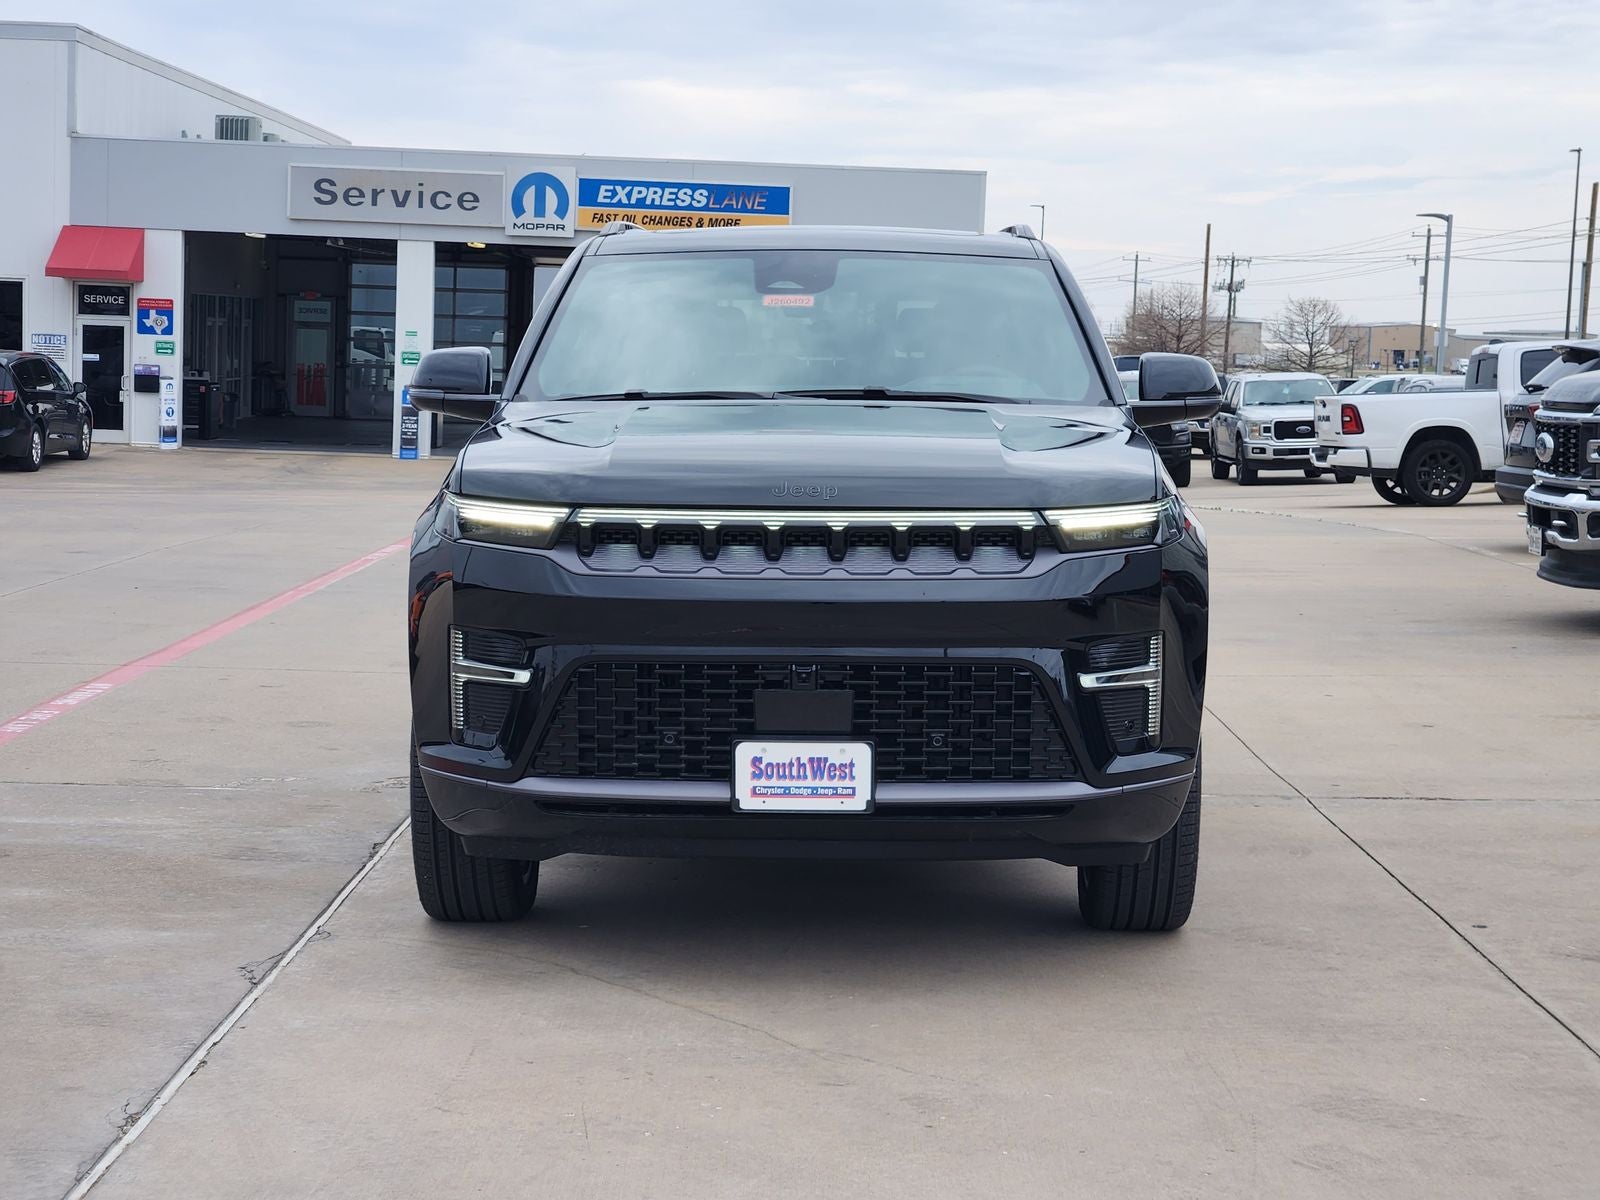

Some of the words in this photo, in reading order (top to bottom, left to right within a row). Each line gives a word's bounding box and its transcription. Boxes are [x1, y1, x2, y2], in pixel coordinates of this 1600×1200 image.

[313, 178, 480, 211] Service
[513, 222, 566, 231] MOPAR
[592, 213, 619, 223] FAST
[621, 214, 638, 224] OIL
[641, 215, 693, 227] CHANGES
[695, 217, 704, 228] &
[707, 218, 741, 227] MORE
[84, 294, 125, 304] SERVICE
[32, 334, 66, 345] NOTICE
[772, 481, 838, 500] Jeep
[750, 755, 856, 782] SouthWest
[755, 786, 784, 795] Chrysler
[790, 786, 812, 796] Dodge
[817, 787, 833, 796] Jeep
[837, 787, 853, 795] Ram
